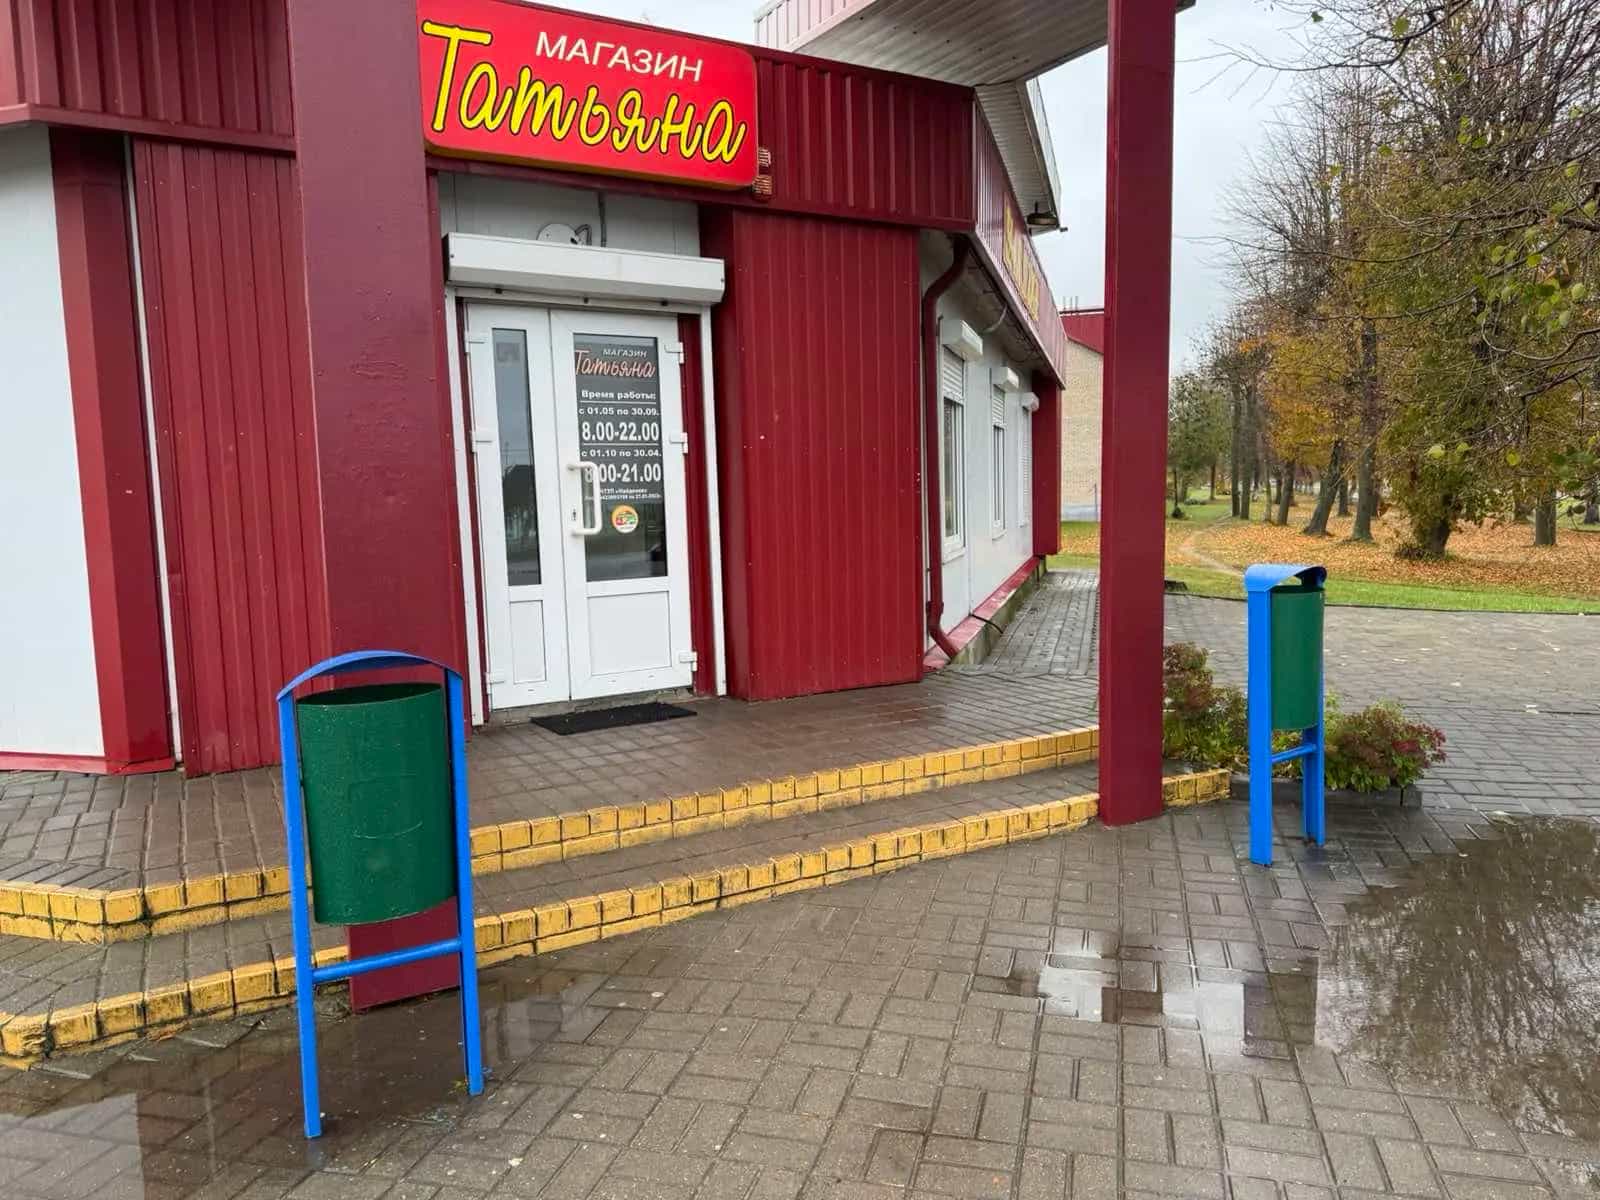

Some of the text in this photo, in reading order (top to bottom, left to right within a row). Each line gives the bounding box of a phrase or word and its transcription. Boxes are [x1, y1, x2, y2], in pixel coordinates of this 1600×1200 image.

[535, 31, 704, 83] МАГАЗИН
[422, 20, 748, 164] Татьяна
[575, 349, 656, 378] Татьяна
[603, 349, 647, 358] МАГАЗИН
[581, 390, 657, 401] Время работы:
[587, 407, 614, 415] 01.05
[582, 421, 660, 441] 8.00-22.00
[590, 449, 617, 457] 01.10
[633, 449, 662, 457] 30.04.
[585, 463, 661, 483] 800-21.00
